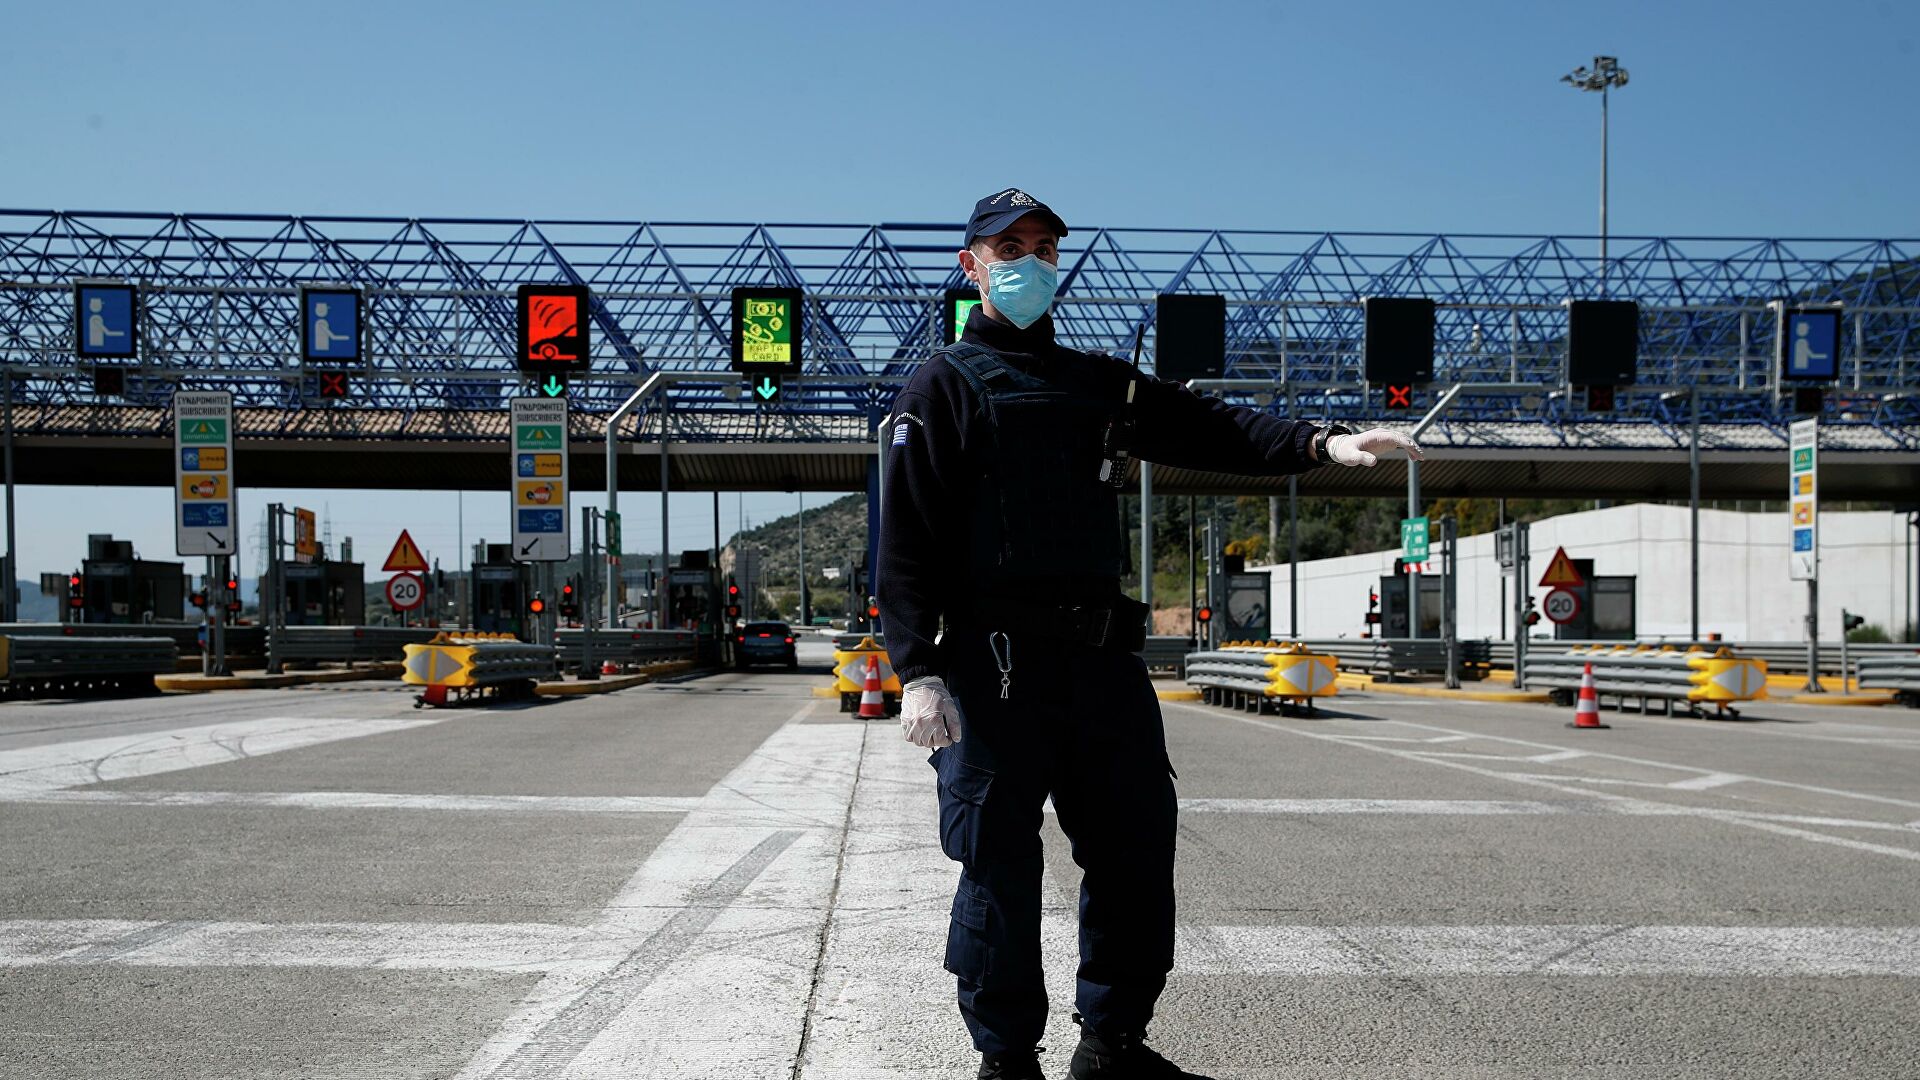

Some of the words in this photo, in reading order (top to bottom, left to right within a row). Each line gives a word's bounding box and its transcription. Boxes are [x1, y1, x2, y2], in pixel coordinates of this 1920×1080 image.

[752, 353, 779, 361] CARD
[177, 396, 228, 404] ΣΥΝΔΡΟΜΗΤΕΣ
[514, 403, 563, 411] ΣΥΝΔΡΟΜΗΤΕΣ
[180, 407, 226, 416] SUBSCRIBERS
[517, 414, 562, 422] SUBSCRIBERS
[395, 584, 417, 598] 20
[1551, 598, 1572, 613] 20
